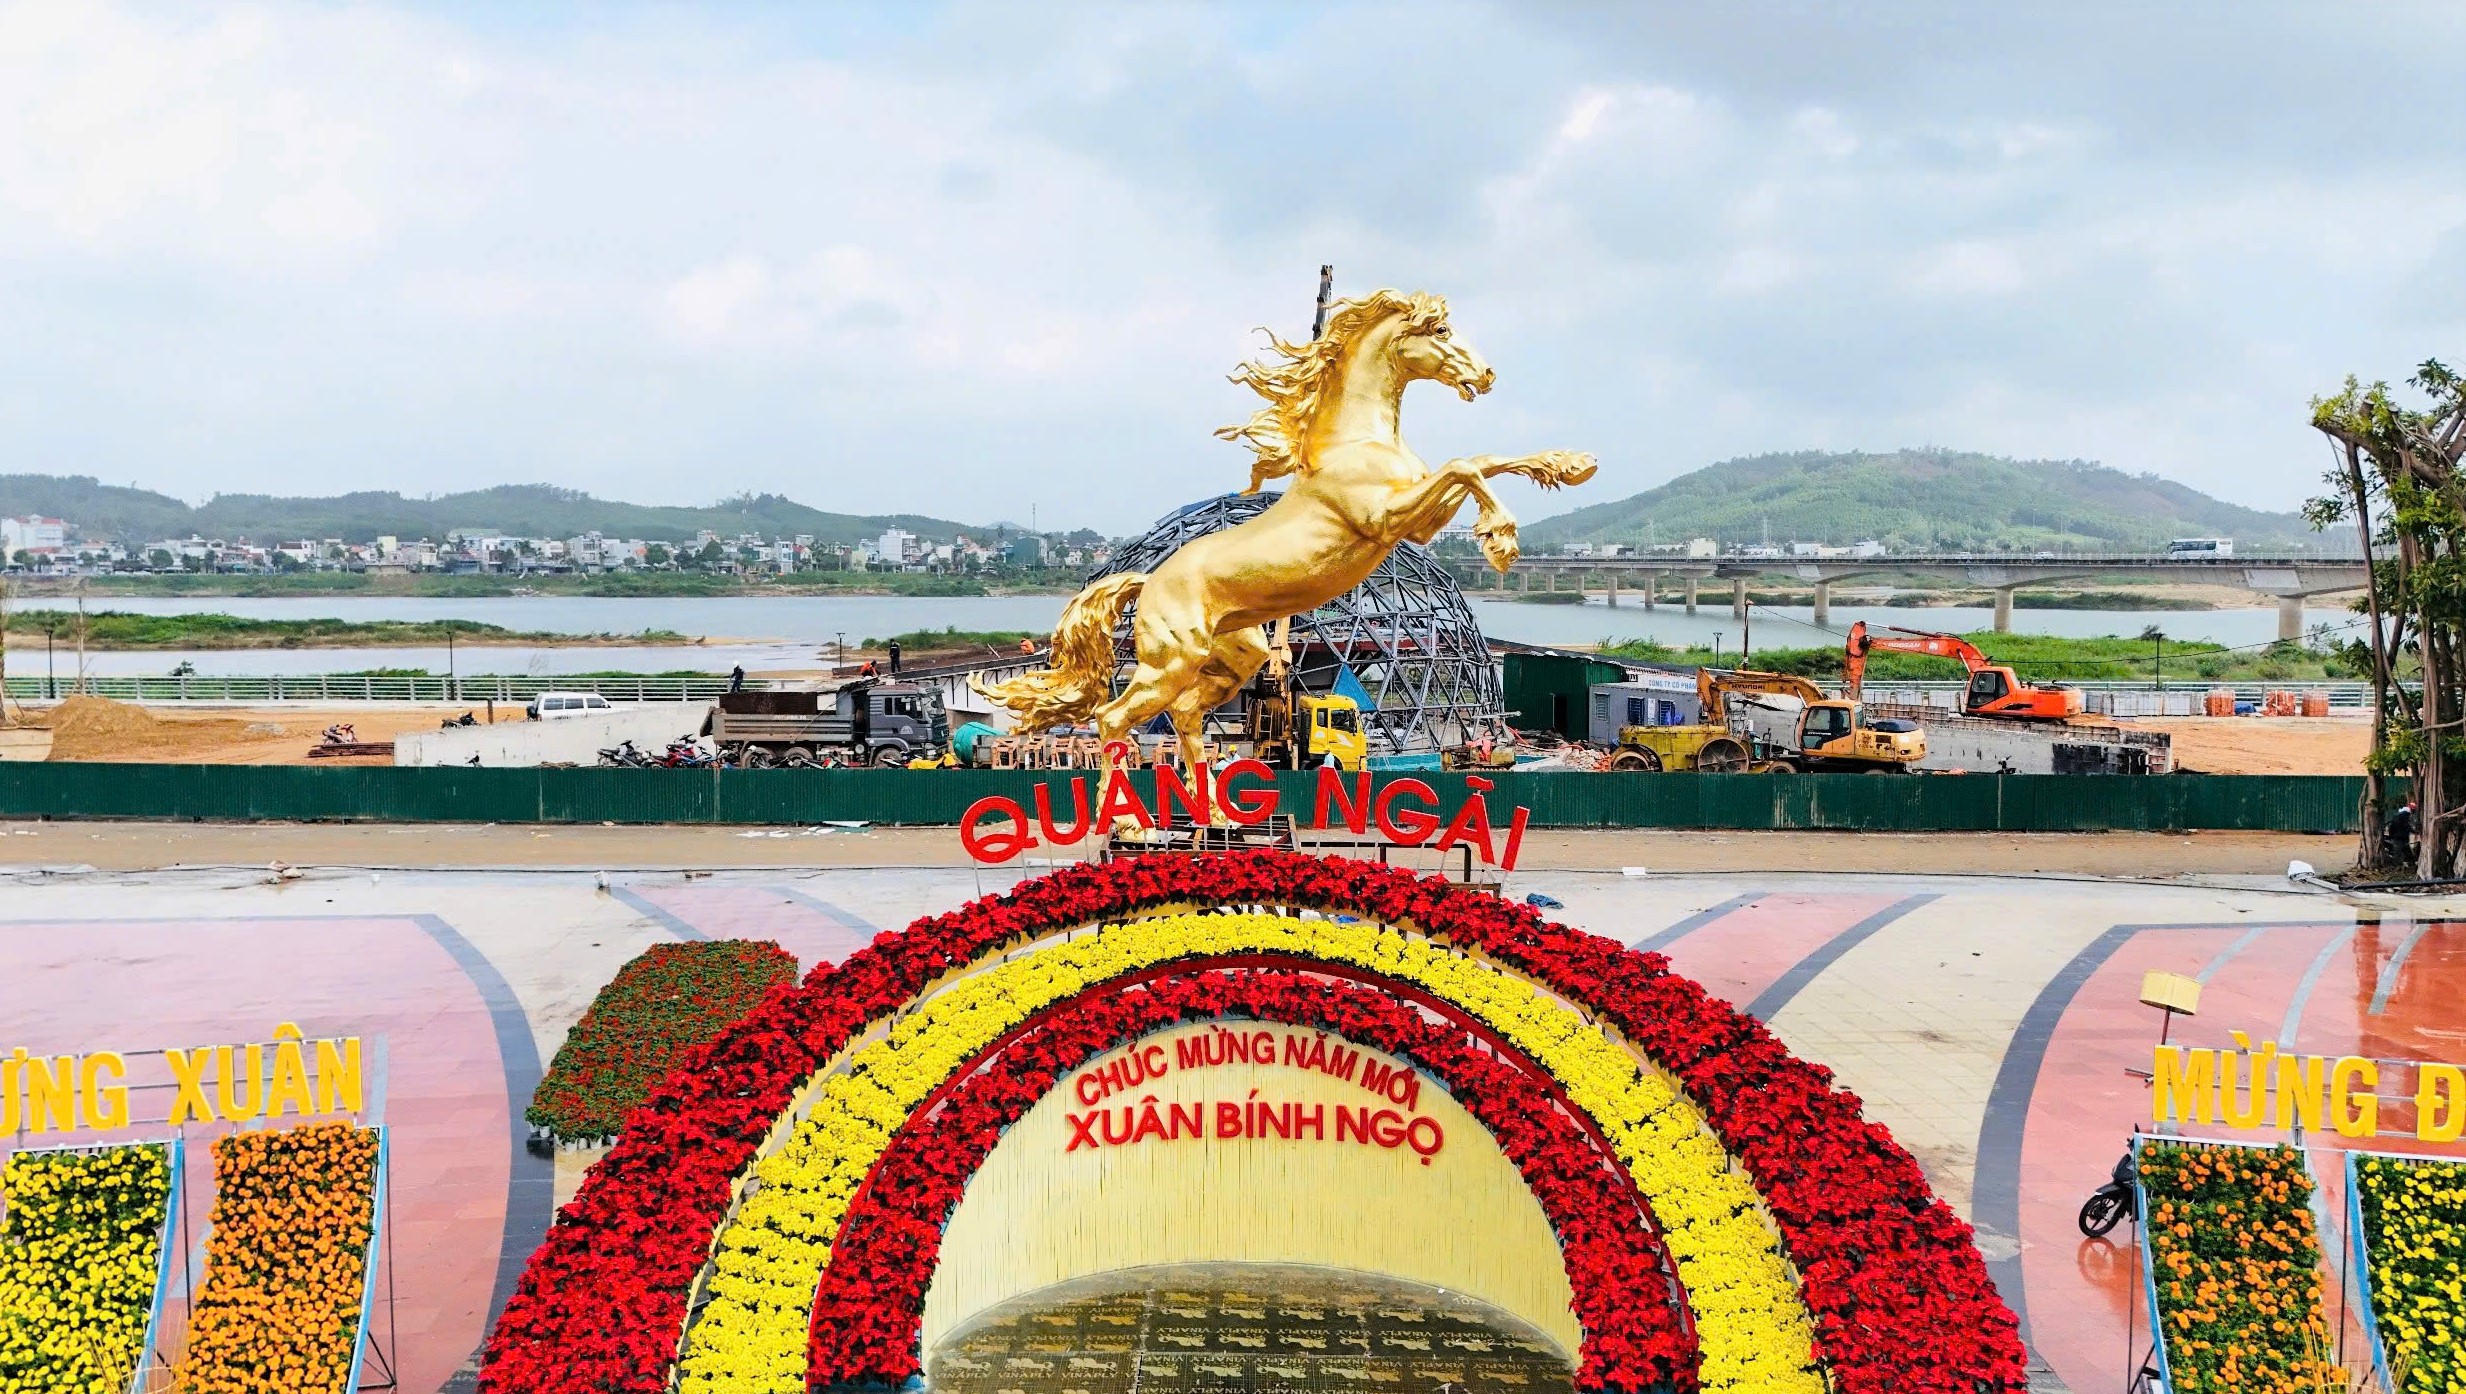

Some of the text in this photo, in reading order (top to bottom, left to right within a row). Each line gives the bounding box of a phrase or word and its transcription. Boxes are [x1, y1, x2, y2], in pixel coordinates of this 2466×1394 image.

[960, 740, 1530, 872] QUẢNG NGÃI
[165, 1021, 363, 1126] XUÂN
[1076, 1040, 1168, 1107] CHÚC
[1176, 1024, 1275, 1070] MỪNG
[1283, 1030, 1358, 1082] NĂM
[2153, 1029, 2466, 1143] MỪNG Đ
[1064, 1088, 1445, 1166] XUÂN BÍNH NGỌ
